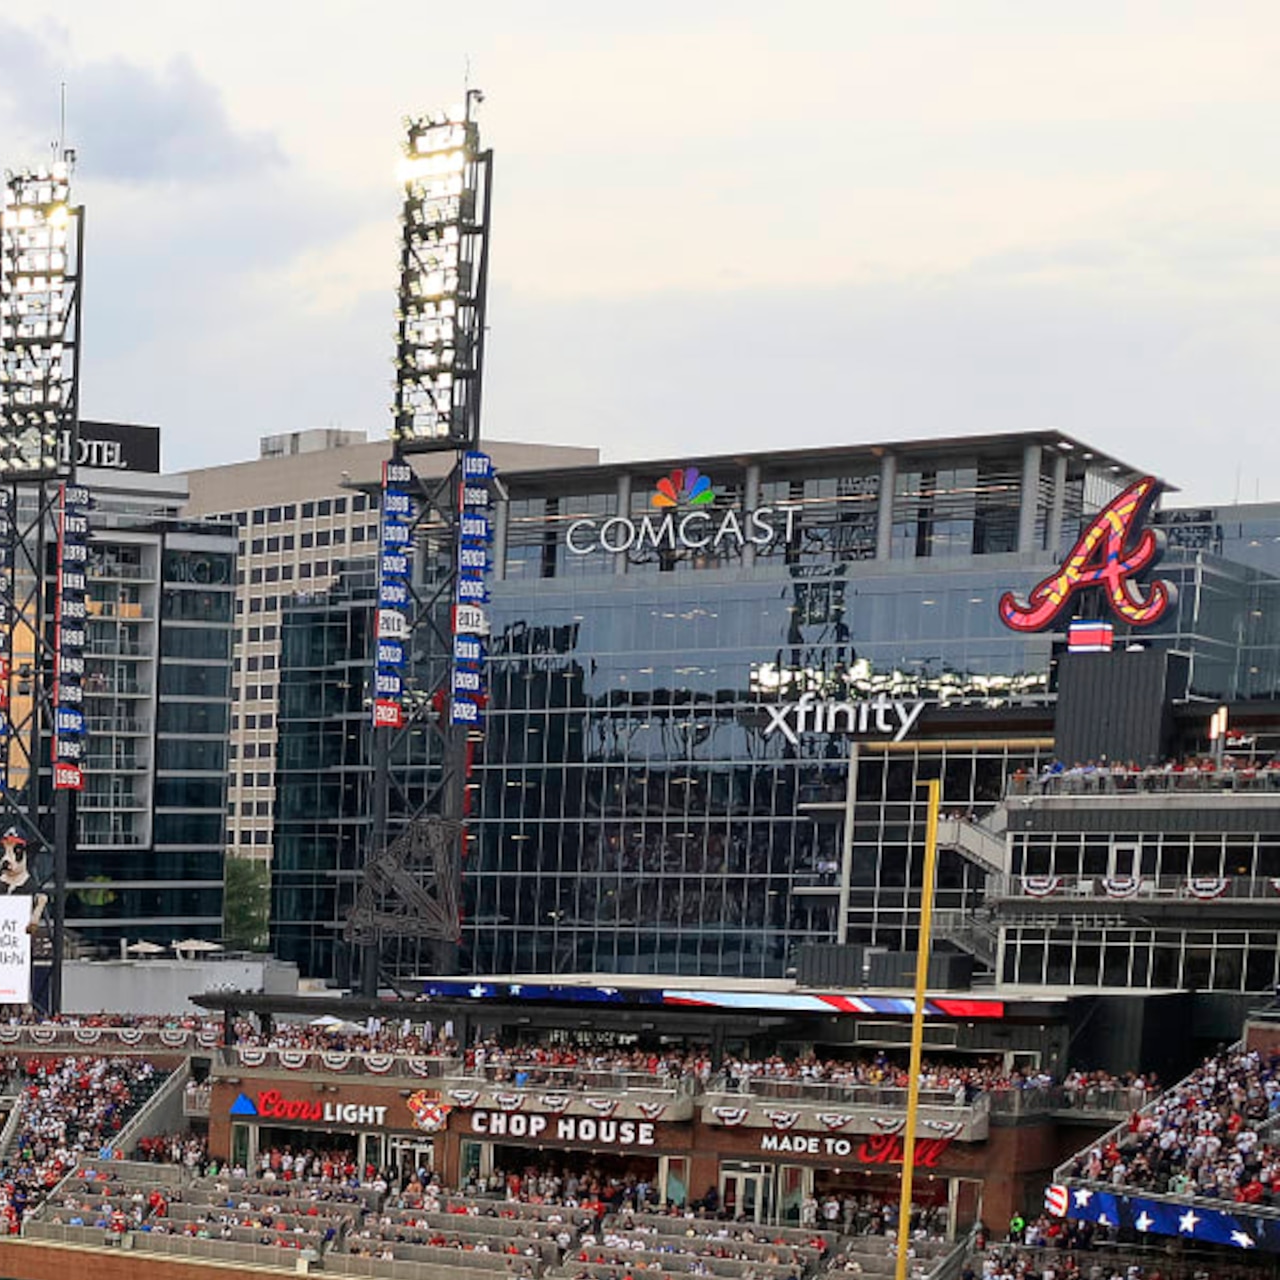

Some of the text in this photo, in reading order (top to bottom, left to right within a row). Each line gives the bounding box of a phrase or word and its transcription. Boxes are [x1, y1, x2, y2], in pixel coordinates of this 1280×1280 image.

[465, 457, 489, 473] 1997
[566, 506, 803, 555] COMCAST
[458, 611, 481, 627] 2012
[764, 692, 927, 745] xfinity
[257, 1089, 388, 1126] Coors LIGHT
[471, 1111, 656, 1146] CHOP HOUSE
[761, 1134, 821, 1154] MADE
[824, 1137, 852, 1157] TO
